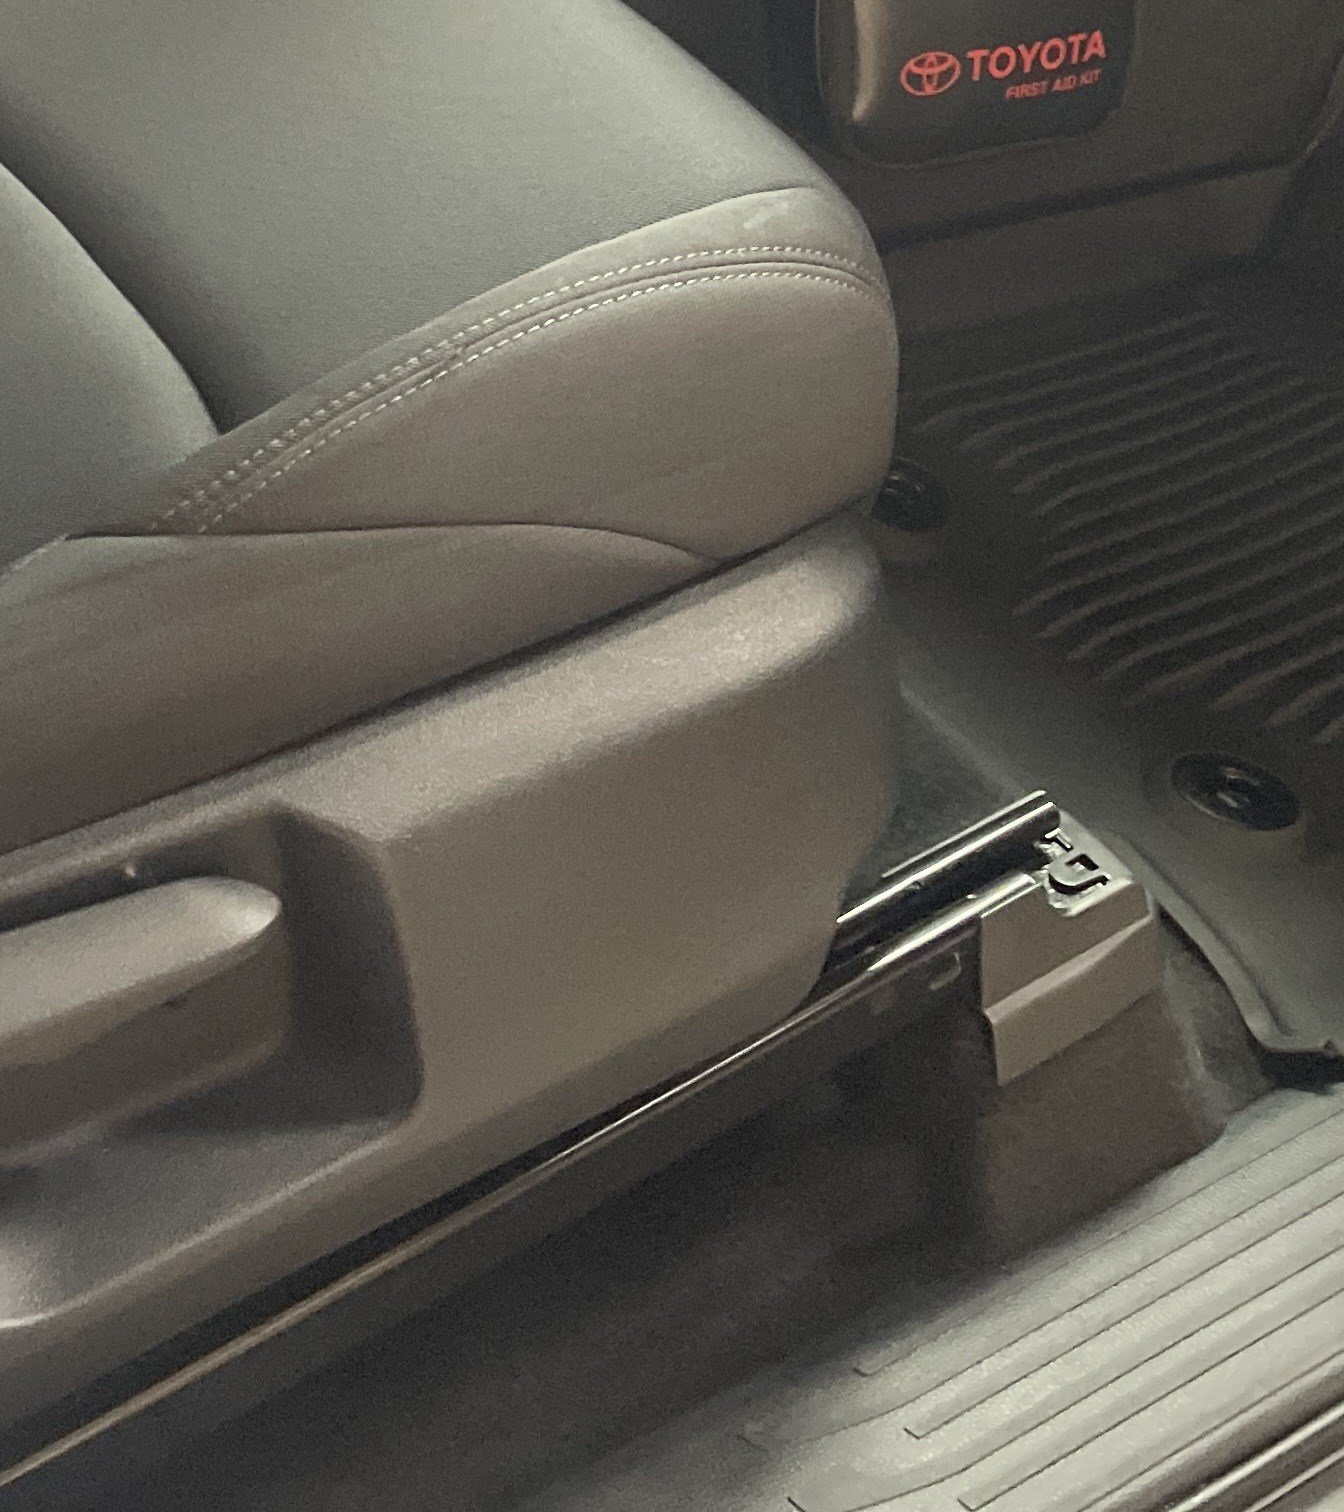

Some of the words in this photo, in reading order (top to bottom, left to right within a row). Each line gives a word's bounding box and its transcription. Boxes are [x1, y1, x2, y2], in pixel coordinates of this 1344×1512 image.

[965, 29, 1106, 82] TOYOTA
[1005, 80, 1048, 99] FIRST
[1051, 75, 1076, 93] AID
[1079, 68, 1102, 87] KIT
